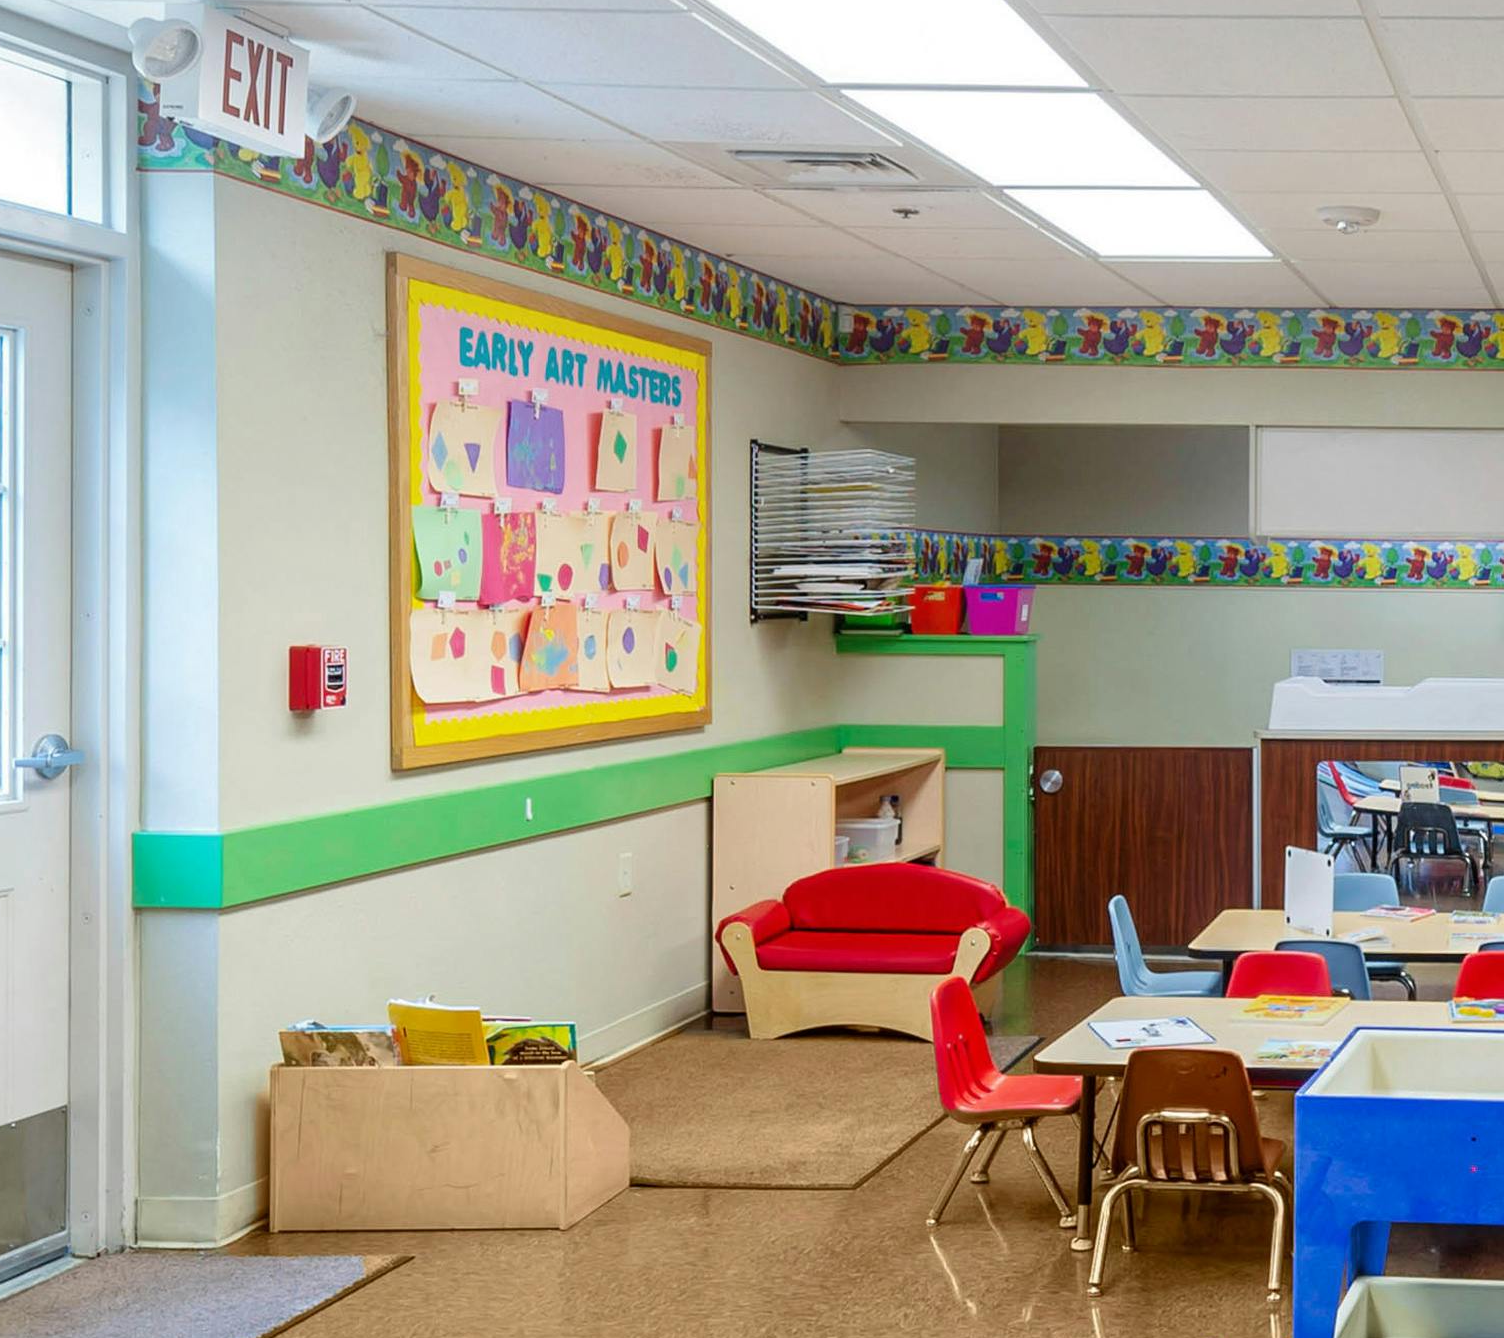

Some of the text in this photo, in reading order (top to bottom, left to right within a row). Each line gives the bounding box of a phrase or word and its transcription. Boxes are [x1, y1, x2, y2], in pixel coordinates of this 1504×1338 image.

[222, 28, 294, 136] EXIT
[459, 326, 682, 407] EARLY ART MASTERS
[324, 649, 345, 662] FIRE
